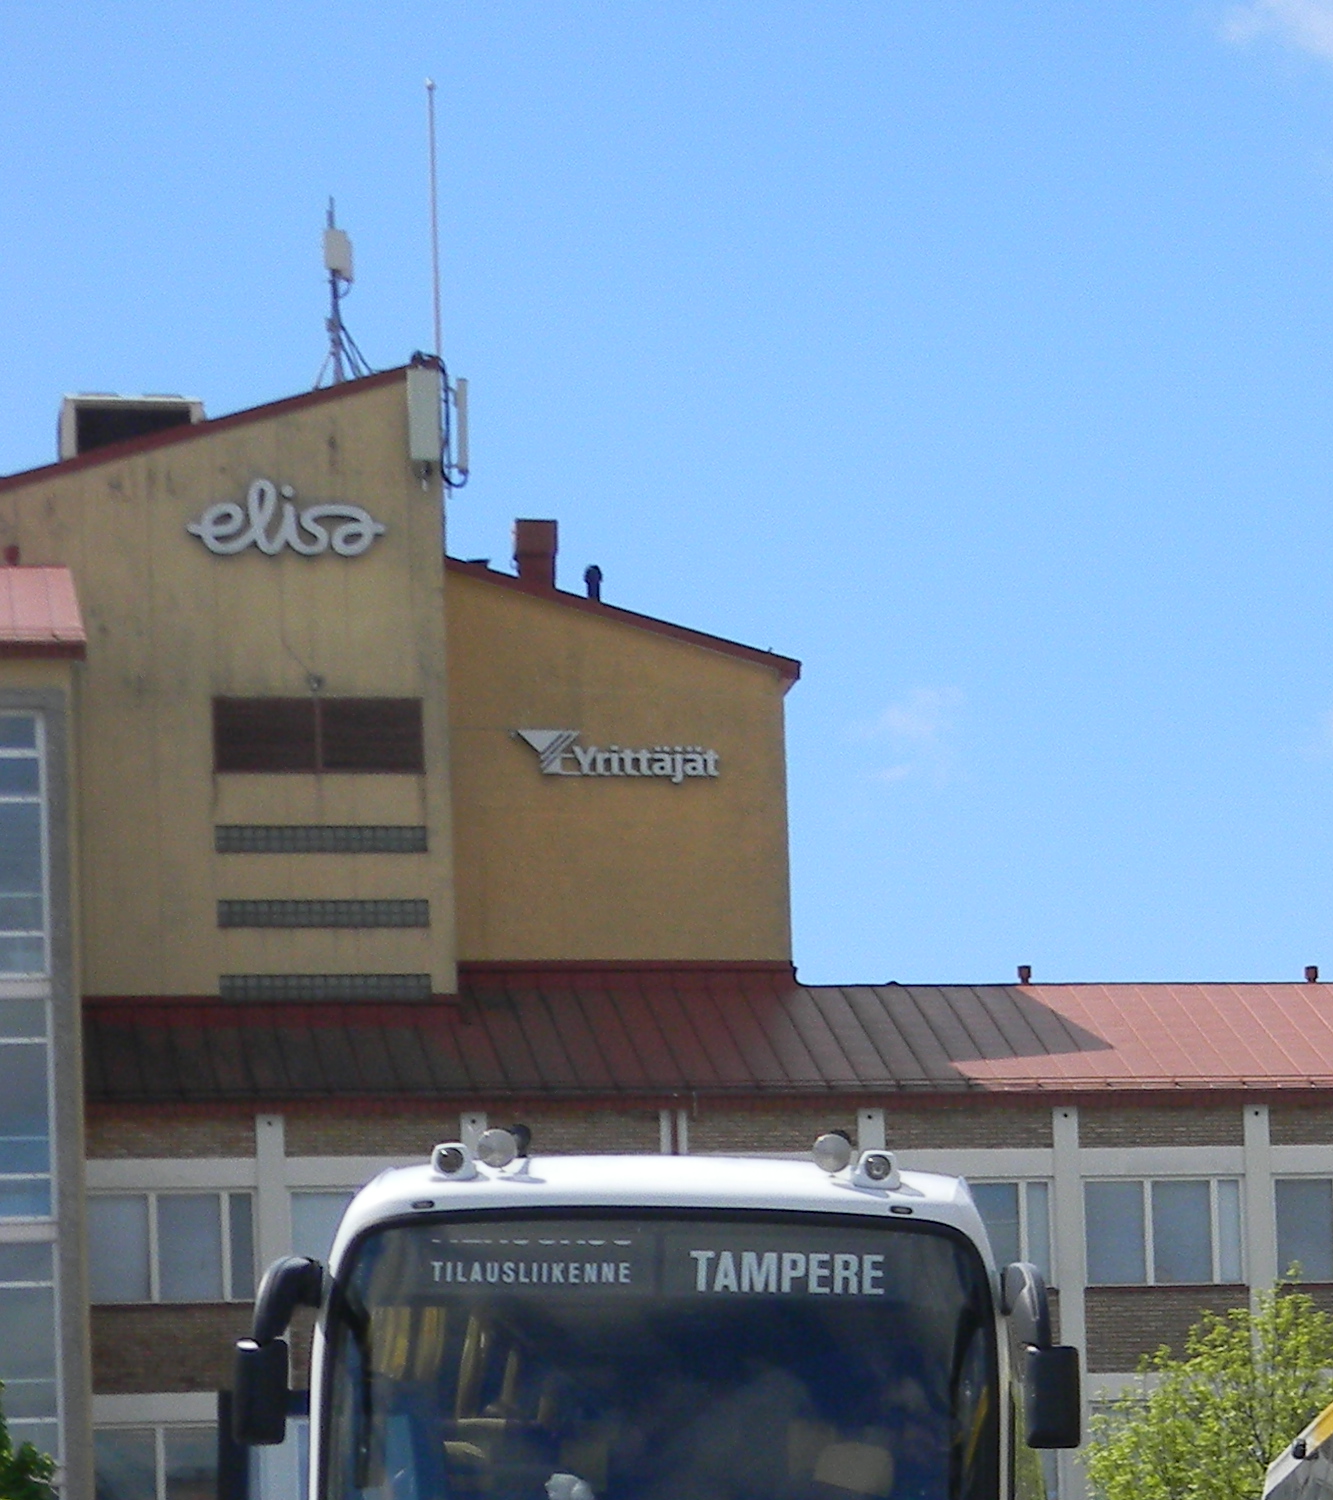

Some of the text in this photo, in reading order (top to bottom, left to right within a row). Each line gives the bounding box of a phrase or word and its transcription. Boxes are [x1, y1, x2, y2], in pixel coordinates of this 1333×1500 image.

[185, 479, 387, 557] elisa
[572, 745, 720, 784] Yrittäjät
[430, 1261, 632, 1284] TILAUSLIIKENNE
[689, 1250, 885, 1296] TAMPERE
